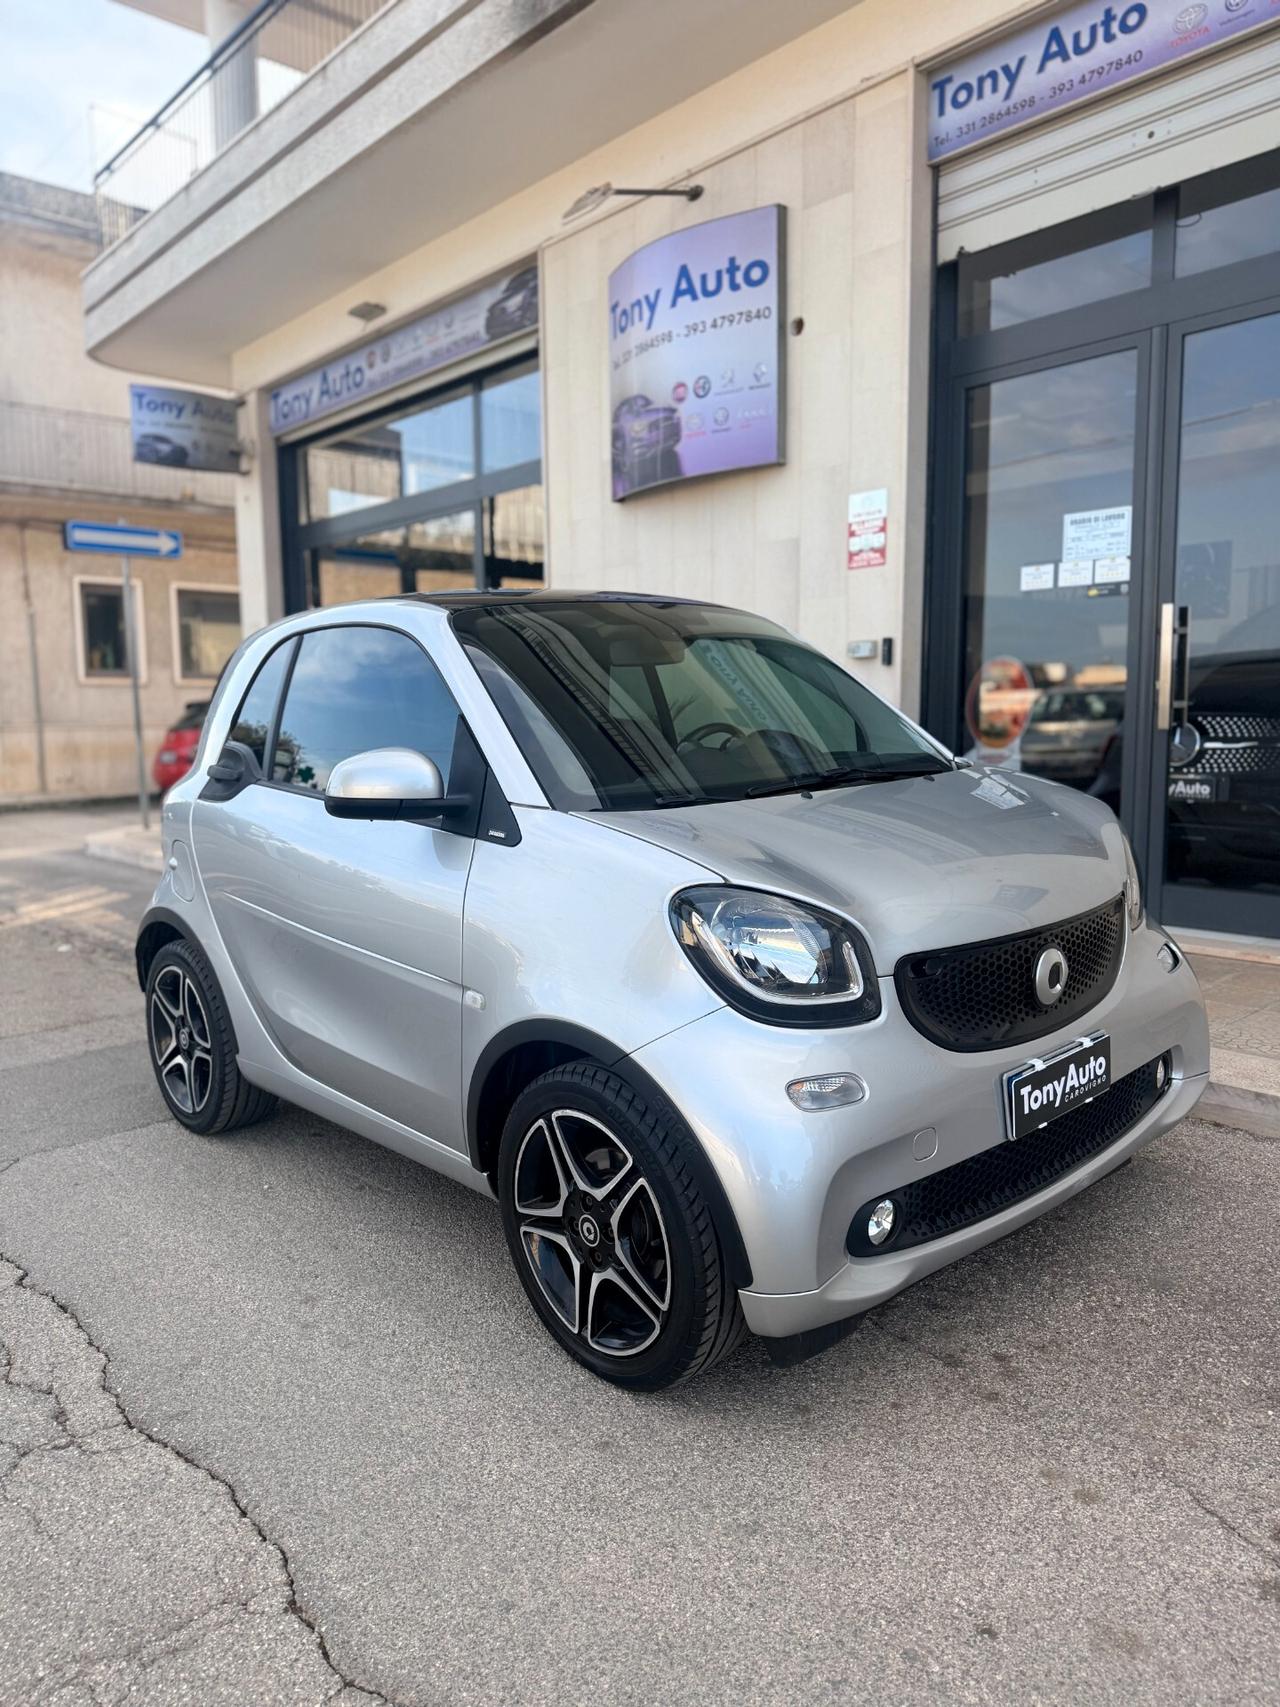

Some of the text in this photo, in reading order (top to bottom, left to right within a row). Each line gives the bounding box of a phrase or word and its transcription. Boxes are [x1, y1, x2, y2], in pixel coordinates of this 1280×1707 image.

[932, 2, 1148, 118] Tony Auto
[1170, 26, 1211, 47] TOYOTA
[933, 131, 952, 147] Tel.
[956, 121, 976, 138] 331
[980, 96, 1036, 128] 2864598
[1049, 79, 1074, 99] 393
[1078, 49, 1143, 85] 4797840
[610, 256, 770, 340] Tony Auto
[684, 320, 706, 338] 393
[711, 306, 772, 330] 4797840
[133, 391, 185, 419] Tony
[272, 364, 365, 424] Tony Auto
[1020, 1055, 1106, 1115] TonyAuto
